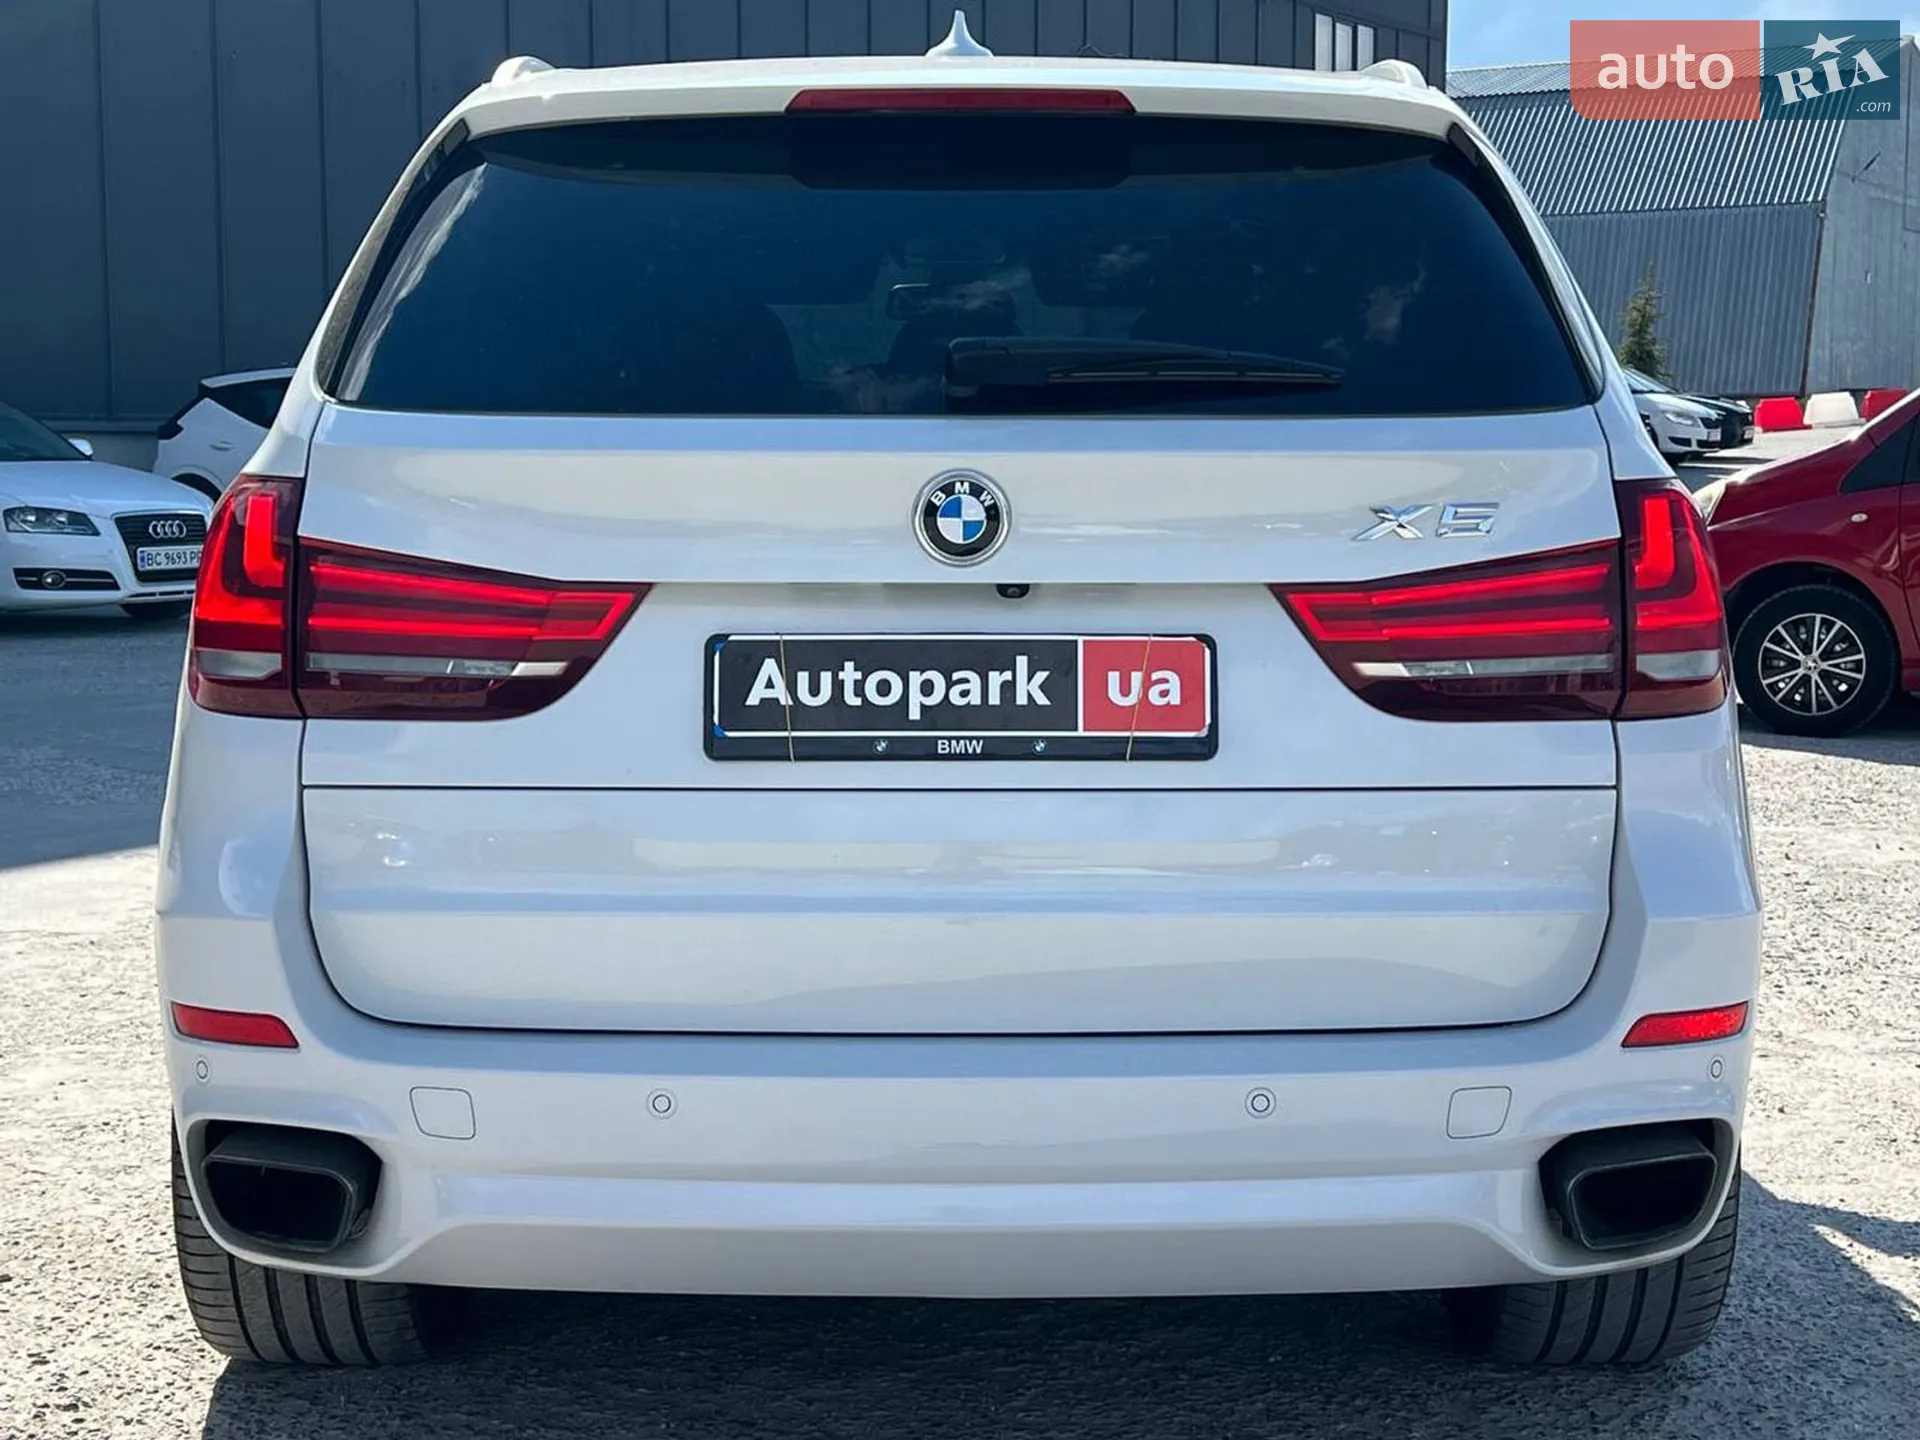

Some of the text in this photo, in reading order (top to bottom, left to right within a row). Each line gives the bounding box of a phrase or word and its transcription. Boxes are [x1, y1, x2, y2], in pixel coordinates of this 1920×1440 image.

[930, 481, 995, 507] BMW
[1352, 502, 1500, 541] X5
[146, 552, 162, 567] BC
[163, 551, 188, 566] 9693
[744, 655, 1182, 721] Autopark ua
[937, 739, 984, 755] BMW
